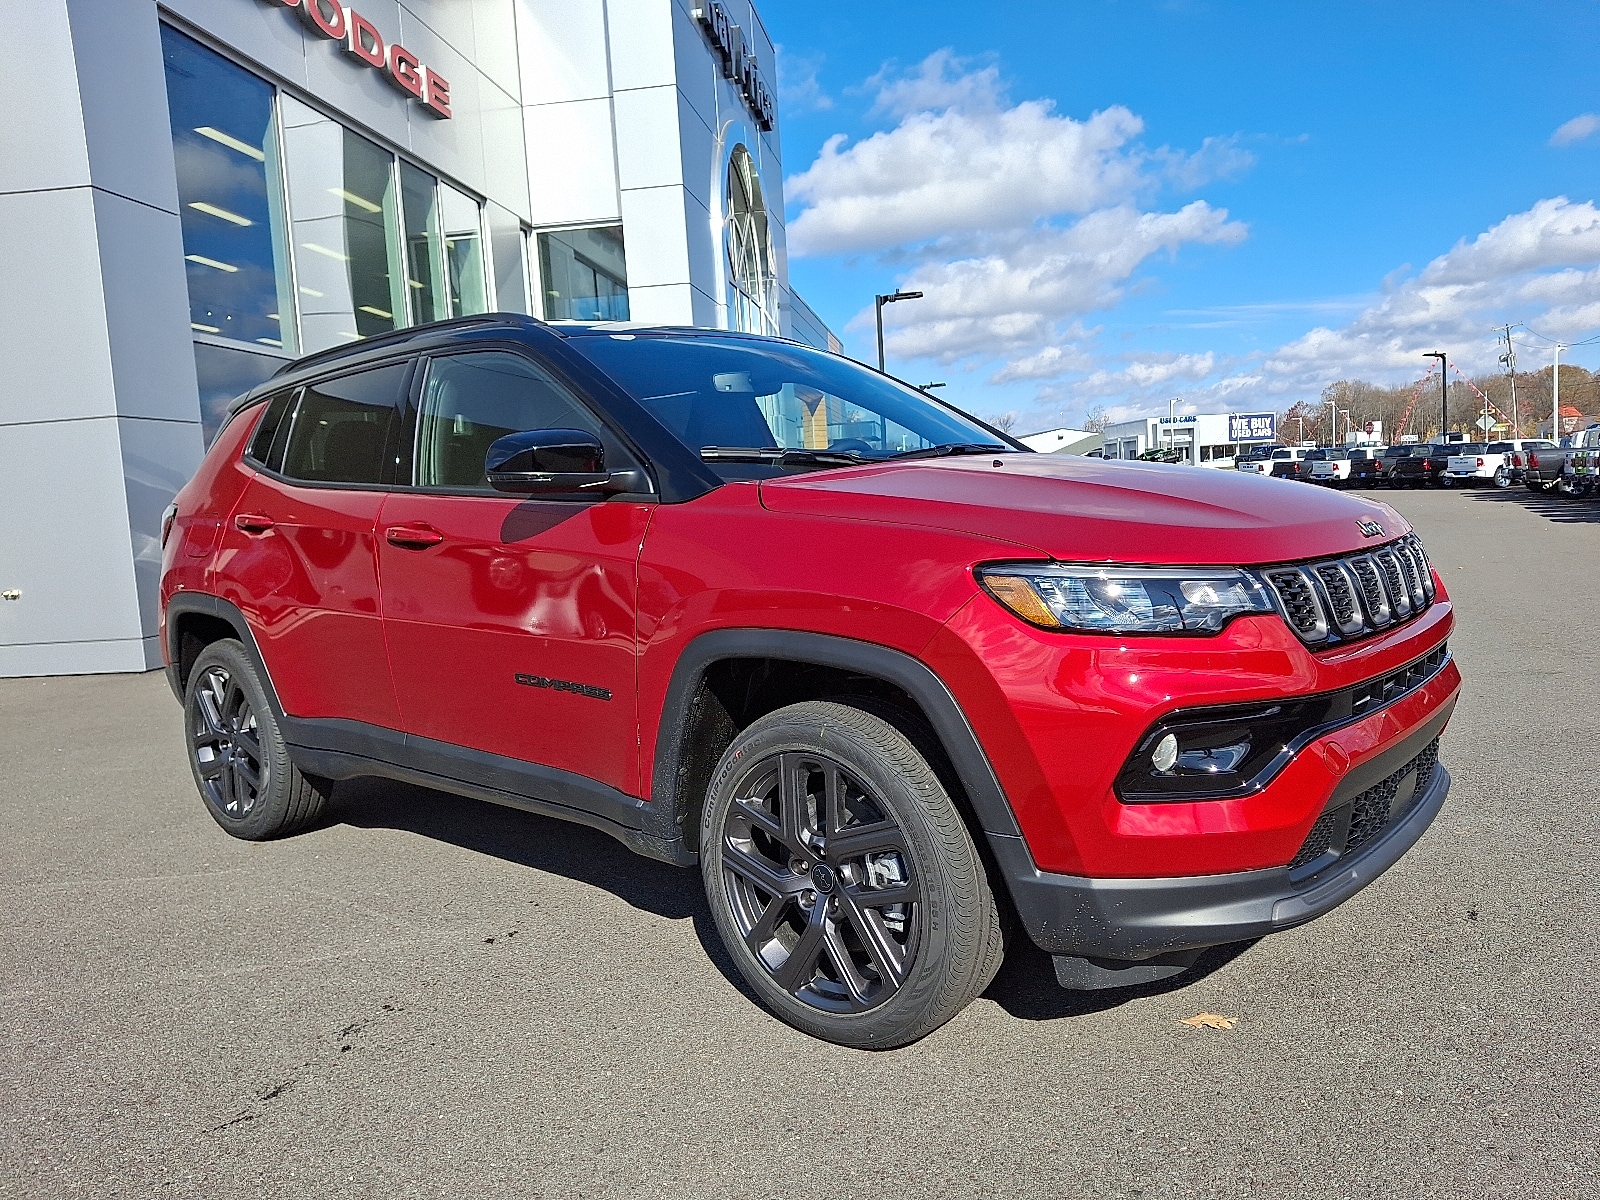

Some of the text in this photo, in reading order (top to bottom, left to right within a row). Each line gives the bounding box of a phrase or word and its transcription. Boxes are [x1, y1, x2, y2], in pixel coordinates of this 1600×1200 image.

[282, 0, 453, 119] ODGE
[1178, 415, 1197, 423] CARS
[1231, 416, 1272, 430] WE BUY
[1252, 428, 1273, 438] CARS
[1355, 520, 1386, 538] Jeep
[514, 672, 613, 701] COMPASS
